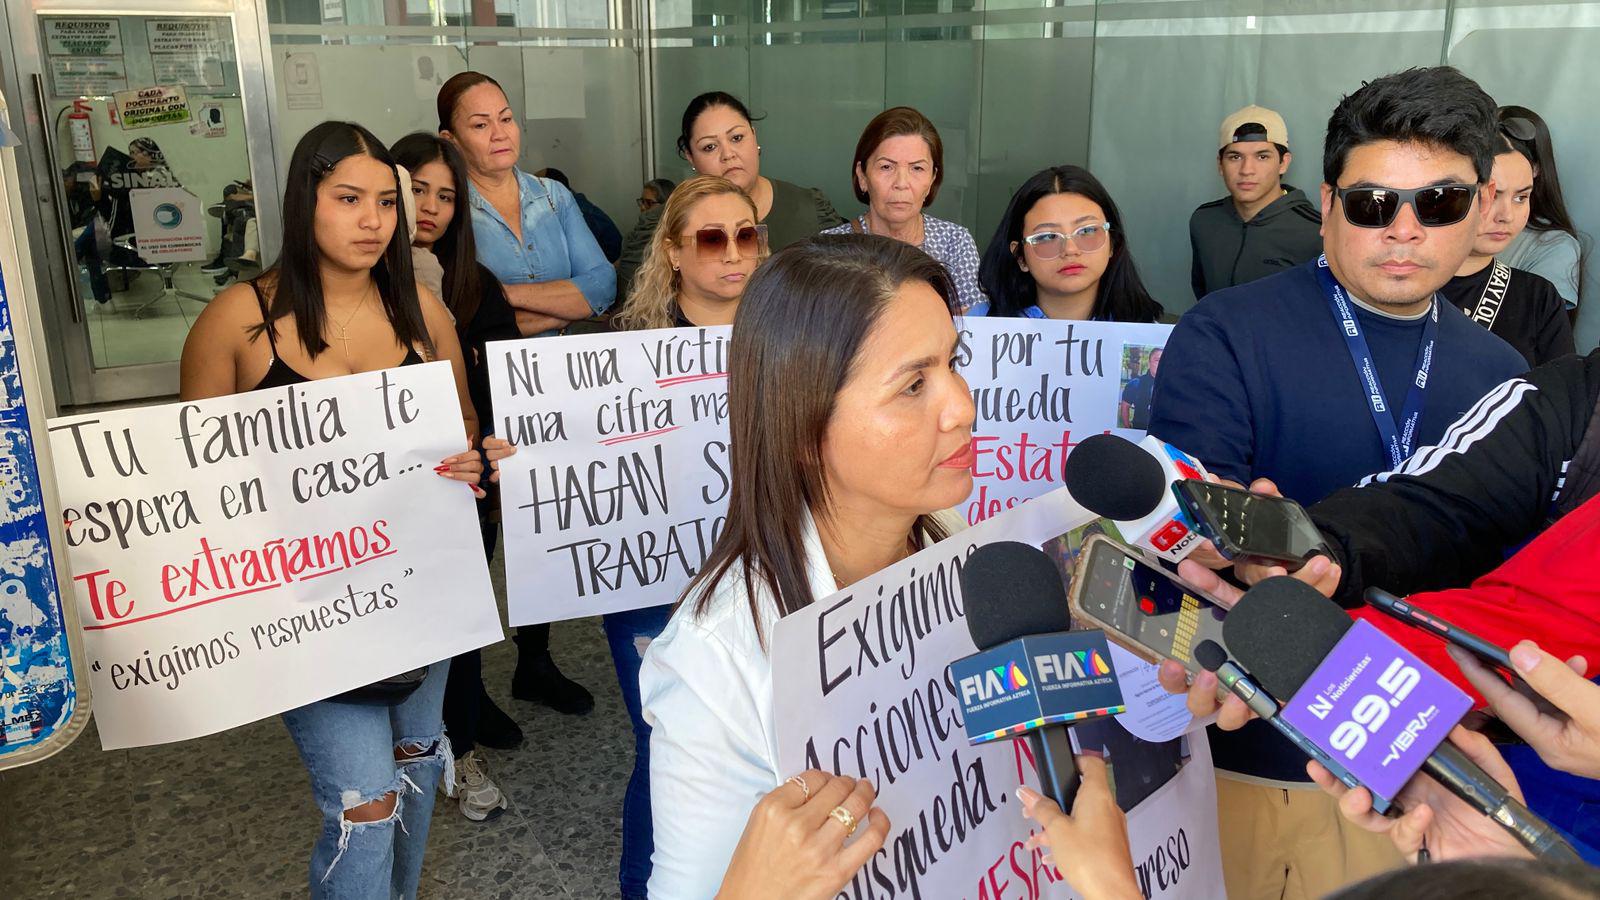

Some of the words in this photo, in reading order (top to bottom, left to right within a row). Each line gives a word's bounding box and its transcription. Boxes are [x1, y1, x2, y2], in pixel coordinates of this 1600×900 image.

[124, 105, 166, 117] ORIGINAL
[168, 103, 186, 111] CON
[126, 96, 179, 108] DOCUMENTO
[138, 89, 163, 98] CADA
[505, 348, 544, 397] Ni
[566, 347, 624, 391] una
[991, 332, 1042, 380] por
[1055, 324, 1104, 377] tu
[48, 419, 149, 479] Tu
[175, 385, 346, 468] familia
[374, 371, 420, 431] te
[504, 409, 568, 446] una
[596, 387, 675, 436] cifra
[63, 488, 201, 549] espera
[220, 476, 268, 521] en
[518, 444, 669, 534] HAGAN
[73, 568, 134, 621] Te
[160, 519, 393, 603] extrañamos
[817, 543, 978, 697] Exigimo
[966, 704, 984, 714] FUERZA
[983, 695, 1013, 709] INFORMATIVA
[1012, 689, 1031, 700] AZTECA
[1042, 683, 1062, 692] FUERZA
[1061, 679, 1094, 689] INFORMATIVA
[1094, 677, 1113, 685] AZTECA
[1323, 683, 1337, 697] Los
[1330, 655, 1372, 701] Noticieristas
[1329, 657, 1421, 760] 99.5
[1382, 705, 1436, 767] VIBRA
